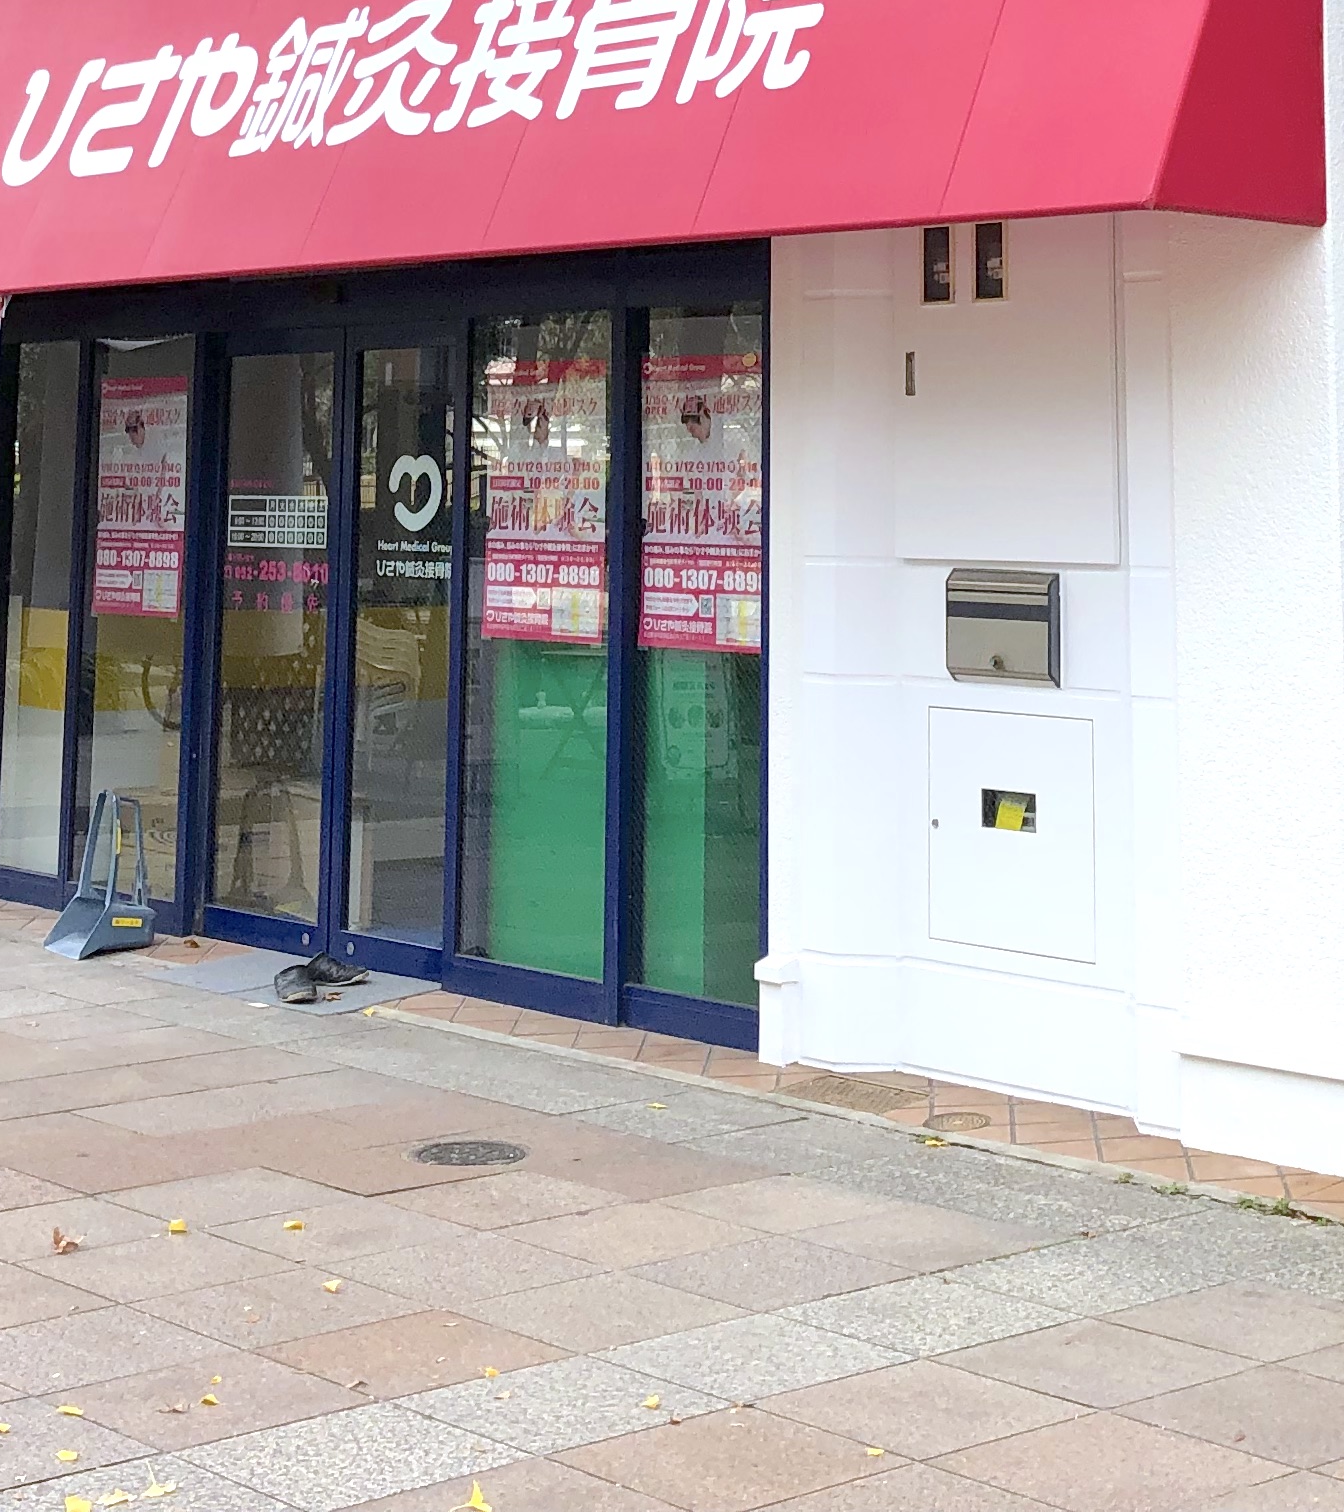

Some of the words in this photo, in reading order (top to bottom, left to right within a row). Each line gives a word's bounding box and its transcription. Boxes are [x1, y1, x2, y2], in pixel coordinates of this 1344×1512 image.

[377, 539, 399, 551] Heart
[400, 540, 430, 552] Medical
[96, 549, 179, 569] 080-1307-8898
[487, 562, 600, 586] 080-1307-8898
